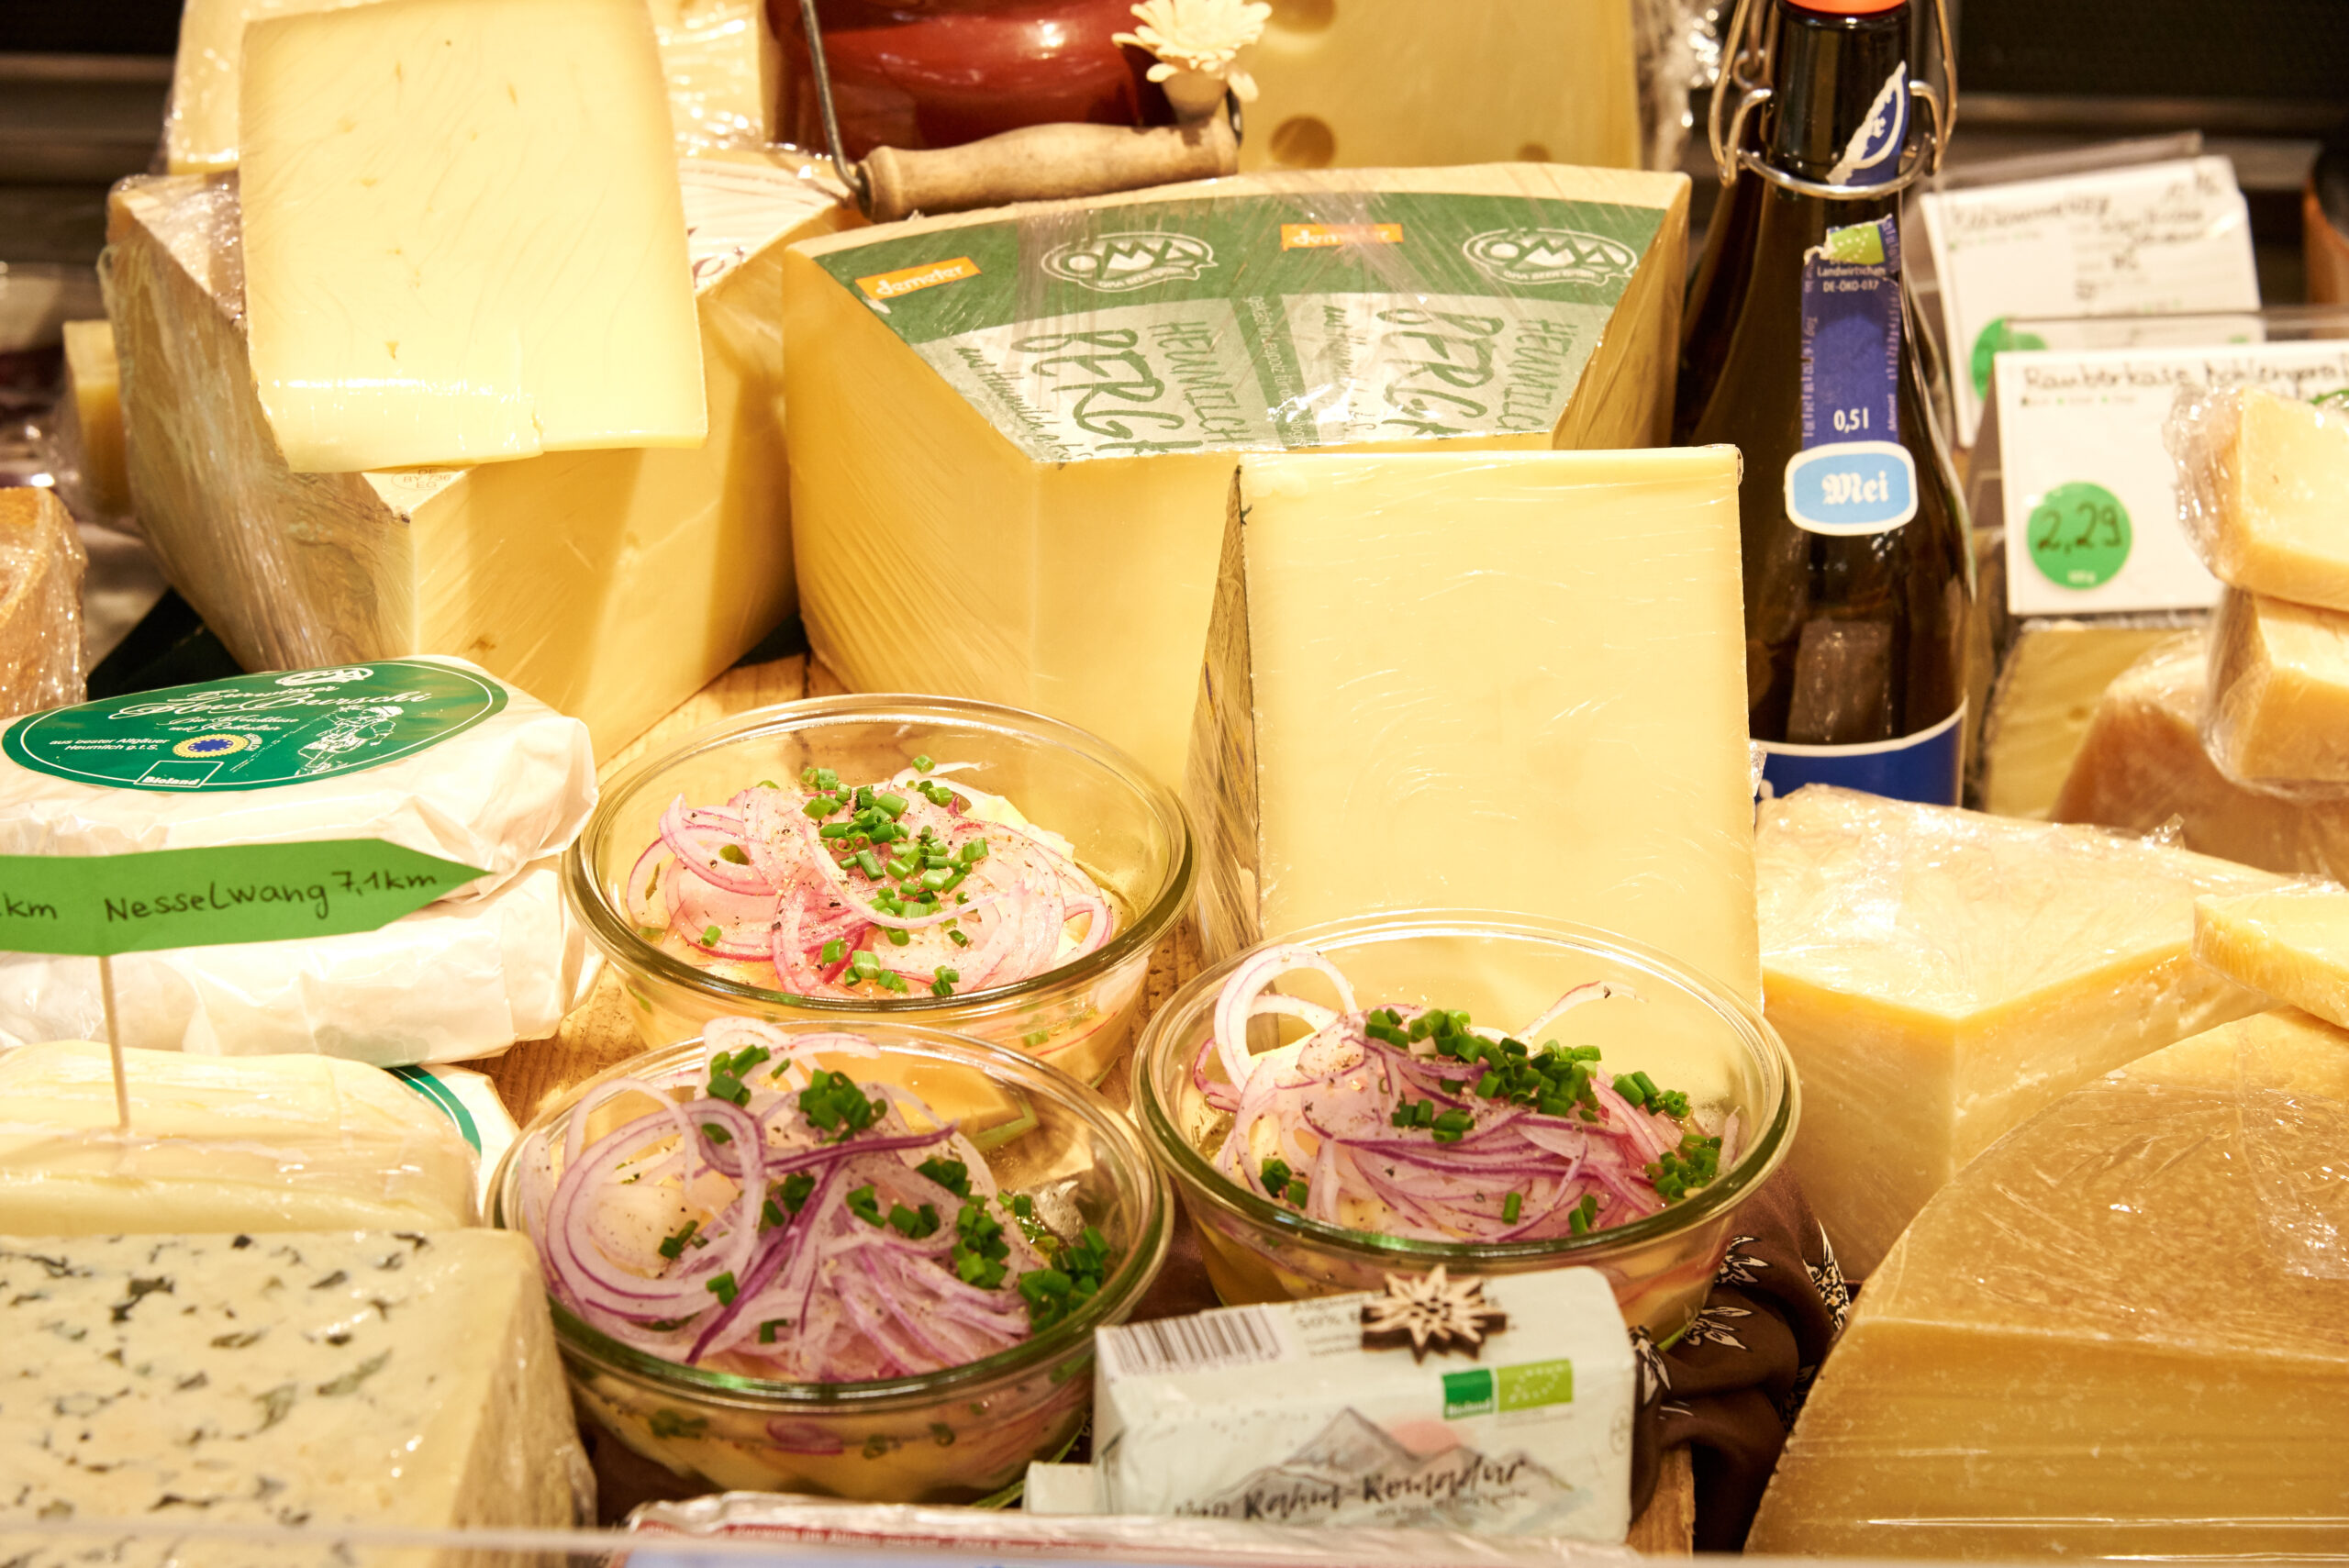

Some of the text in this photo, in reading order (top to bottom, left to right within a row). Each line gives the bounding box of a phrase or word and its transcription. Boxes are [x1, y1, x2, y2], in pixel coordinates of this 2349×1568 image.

[875, 263, 964, 296] demeter
[1820, 471, 1889, 506] Mei
[2035, 501, 2124, 555] 2,29
[74, 737, 115, 745] bester
[116, 736, 171, 746] Allgäuer
[141, 775, 201, 786] Bioland
[0, 892, 58, 920] km
[104, 870, 438, 922] Nesselwang 7,1km
